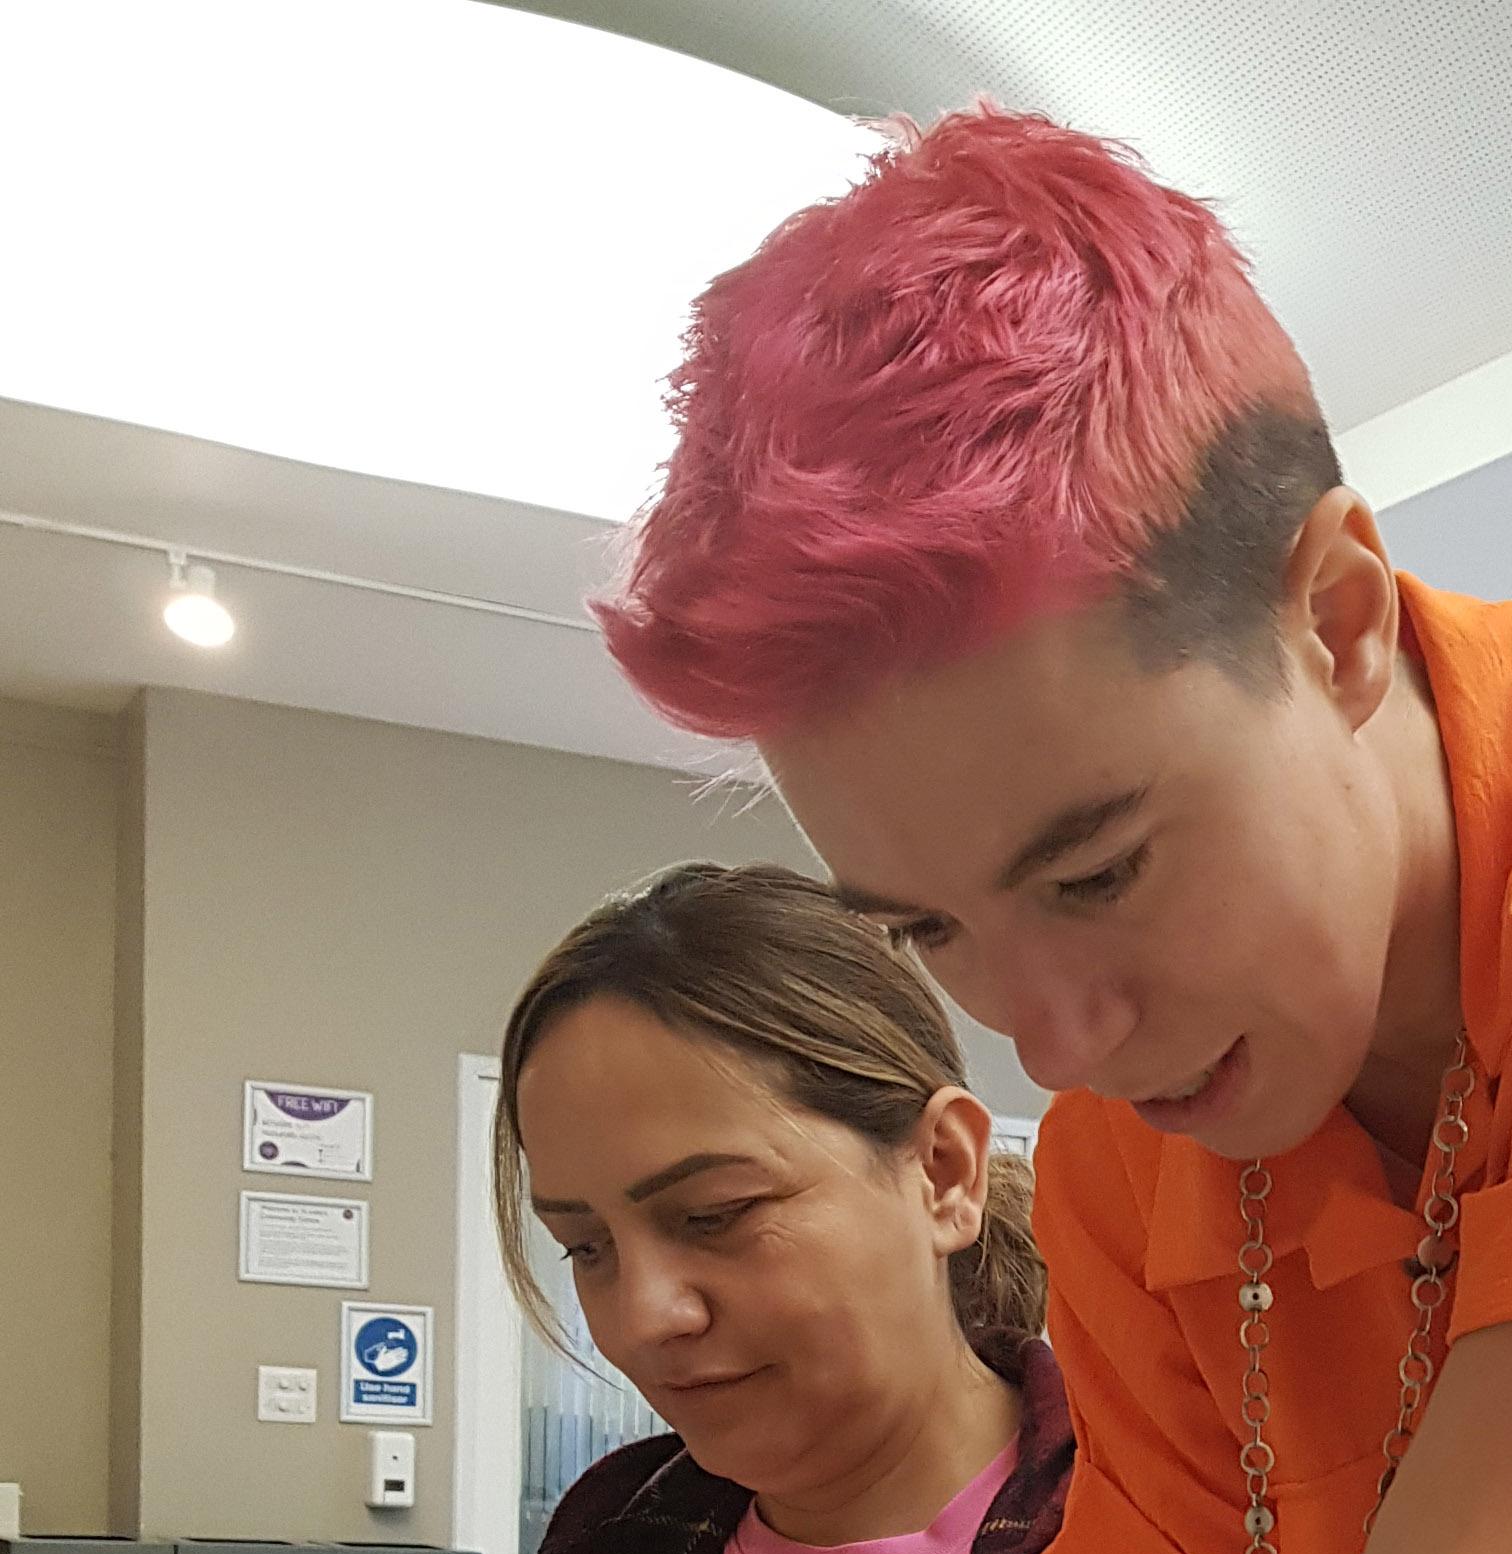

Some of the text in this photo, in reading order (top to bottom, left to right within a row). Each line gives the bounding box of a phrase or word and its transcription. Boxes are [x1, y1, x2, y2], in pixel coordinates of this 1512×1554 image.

[277, 1094, 309, 1111] FREE
[360, 1382, 411, 1394] Use hand
